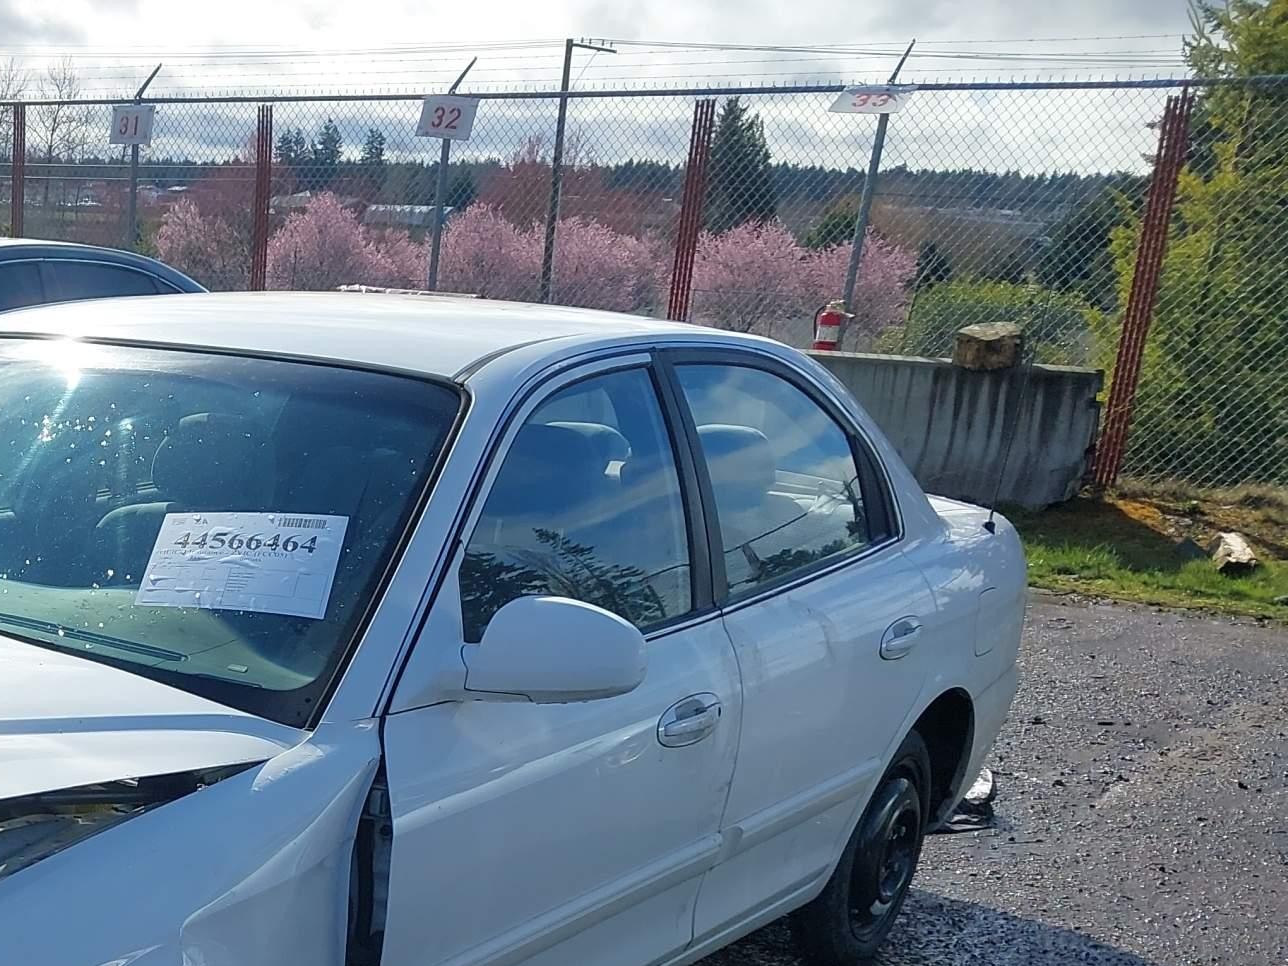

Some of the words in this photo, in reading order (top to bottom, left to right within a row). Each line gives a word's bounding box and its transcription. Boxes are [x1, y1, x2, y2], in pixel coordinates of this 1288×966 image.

[852, 93, 892, 107] 33
[119, 115, 139, 136] 31
[431, 106, 462, 130] 32
[174, 531, 317, 554] 44566464
